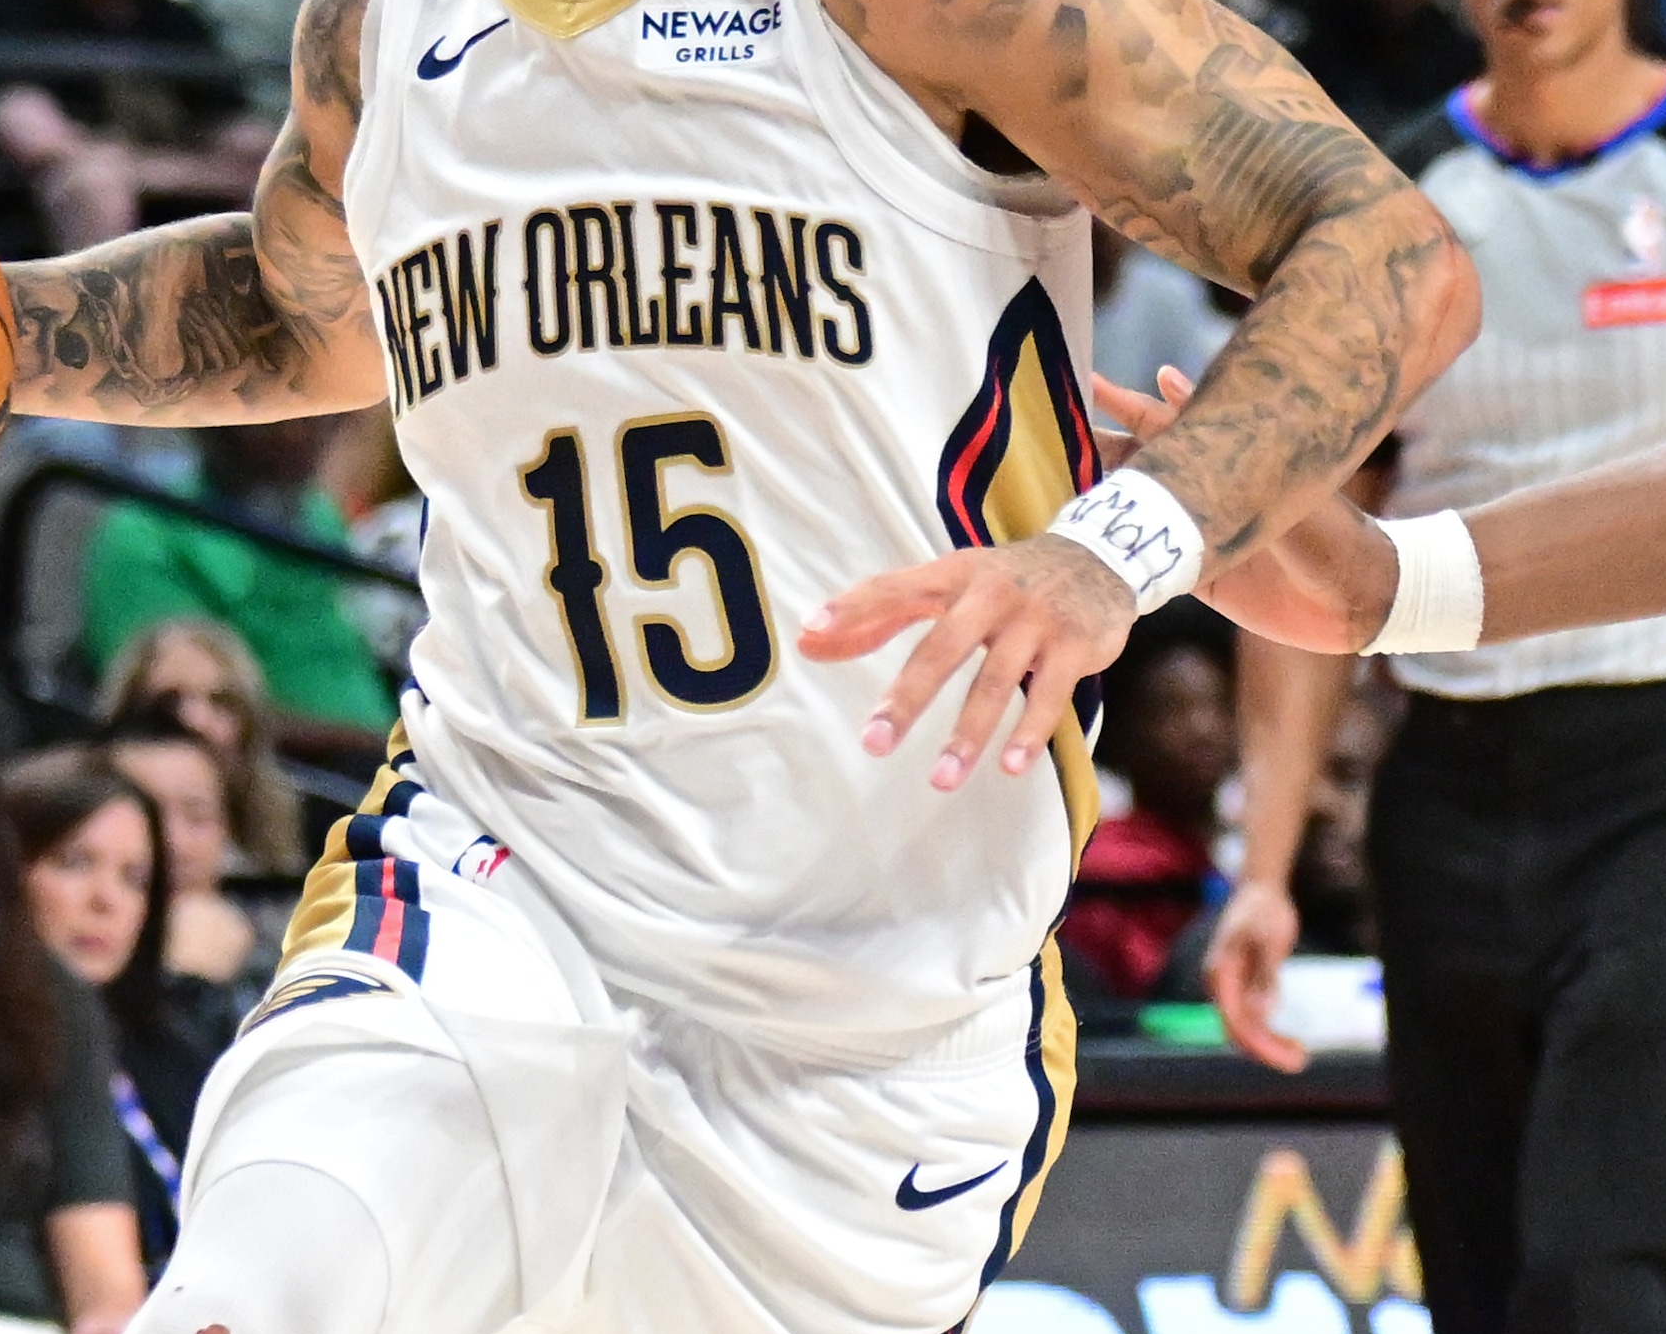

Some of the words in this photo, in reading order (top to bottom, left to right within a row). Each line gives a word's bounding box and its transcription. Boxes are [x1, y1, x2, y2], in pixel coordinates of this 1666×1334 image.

[641, 0, 783, 40] NEWAGE
[675, 44, 755, 63] GRILLS
[375, 218, 502, 423] NEW
[522, 200, 875, 370] ORLEANS
[516, 409, 779, 729] 15
